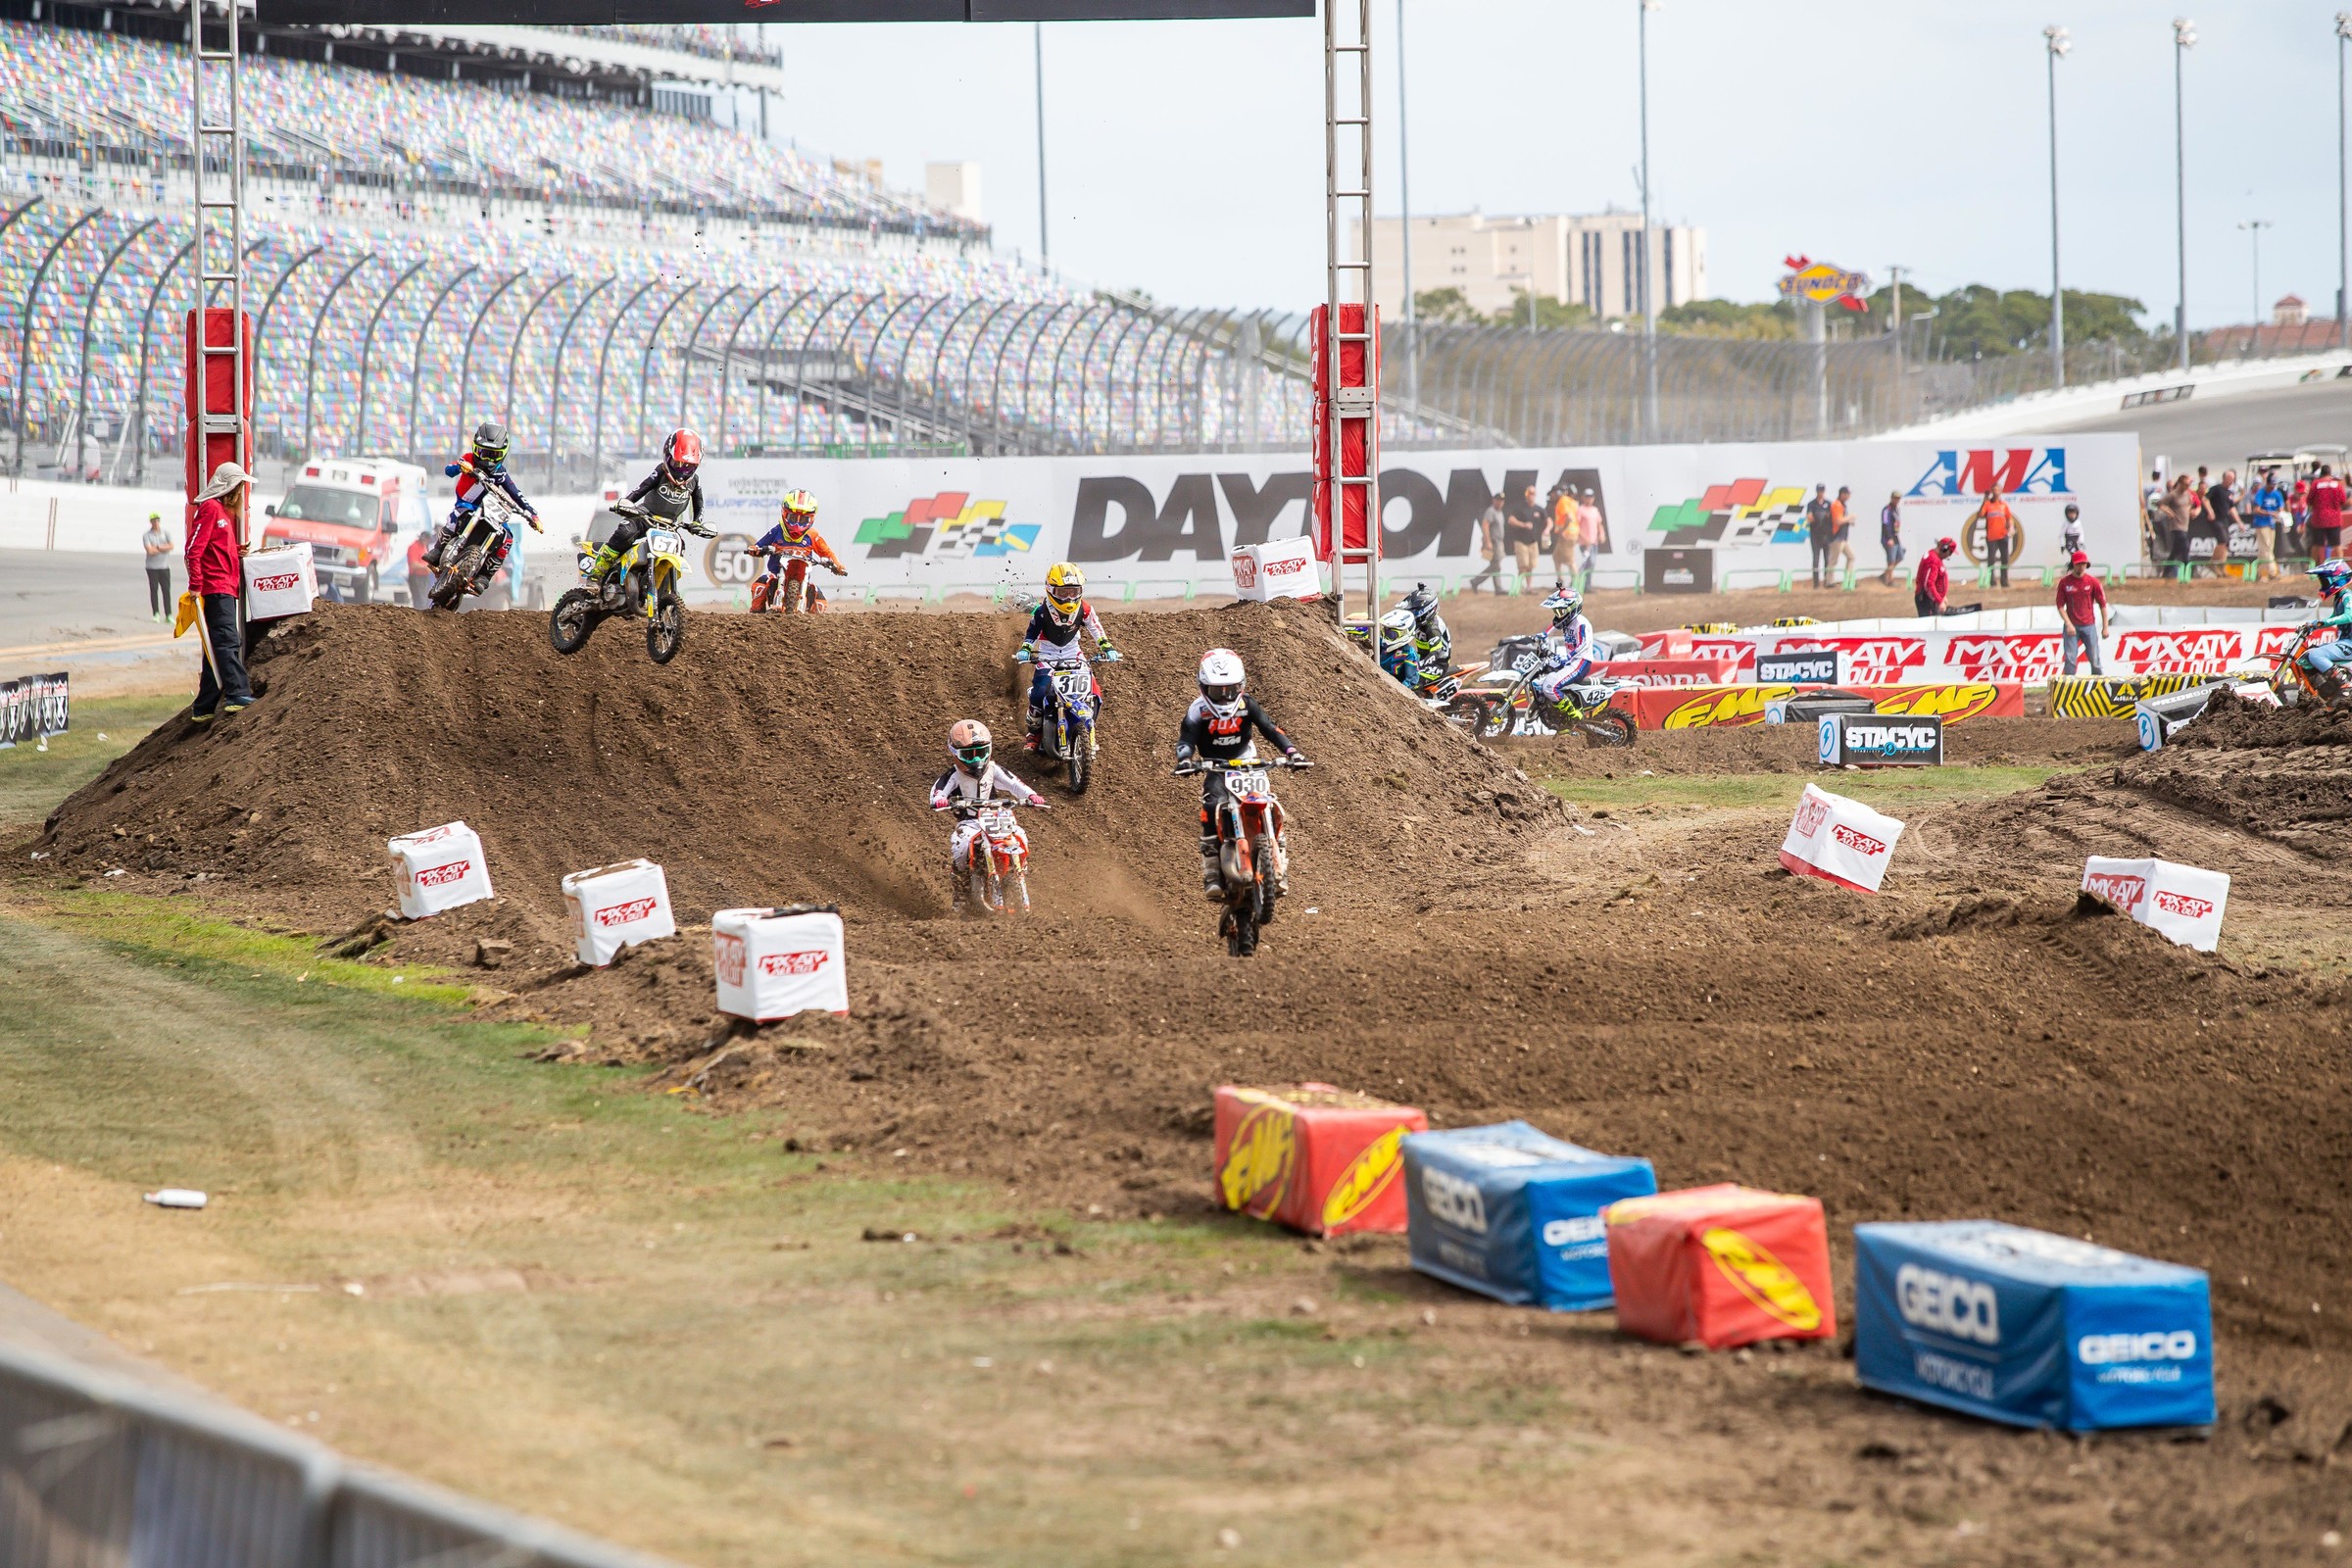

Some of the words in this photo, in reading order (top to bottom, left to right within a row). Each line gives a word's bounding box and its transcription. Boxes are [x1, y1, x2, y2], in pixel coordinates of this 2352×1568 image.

[1782, 273, 1862, 293] SUNOCO
[1904, 448, 2073, 496] AMA
[486, 499, 510, 522] 278
[654, 536, 677, 553] 67
[713, 552, 755, 581] 50
[1850, 642, 1926, 667] ATV
[1953, 639, 2022, 665] MX
[2121, 636, 2186, 662] MX
[2189, 634, 2240, 659] ATV
[1760, 660, 1834, 680] STACYC
[1975, 664, 2022, 683] ALL
[1058, 675, 1088, 694] 316
[1437, 682, 1457, 702] 55
[1587, 688, 1606, 703] 425
[1208, 716, 1241, 732] FOX
[1212, 735, 1241, 746] KTM
[1845, 724, 1936, 749] STACYC
[1232, 778, 1266, 794] 930
[1896, 1261, 2001, 1347] GEICO
[2078, 1330, 2197, 1365] GEICO
